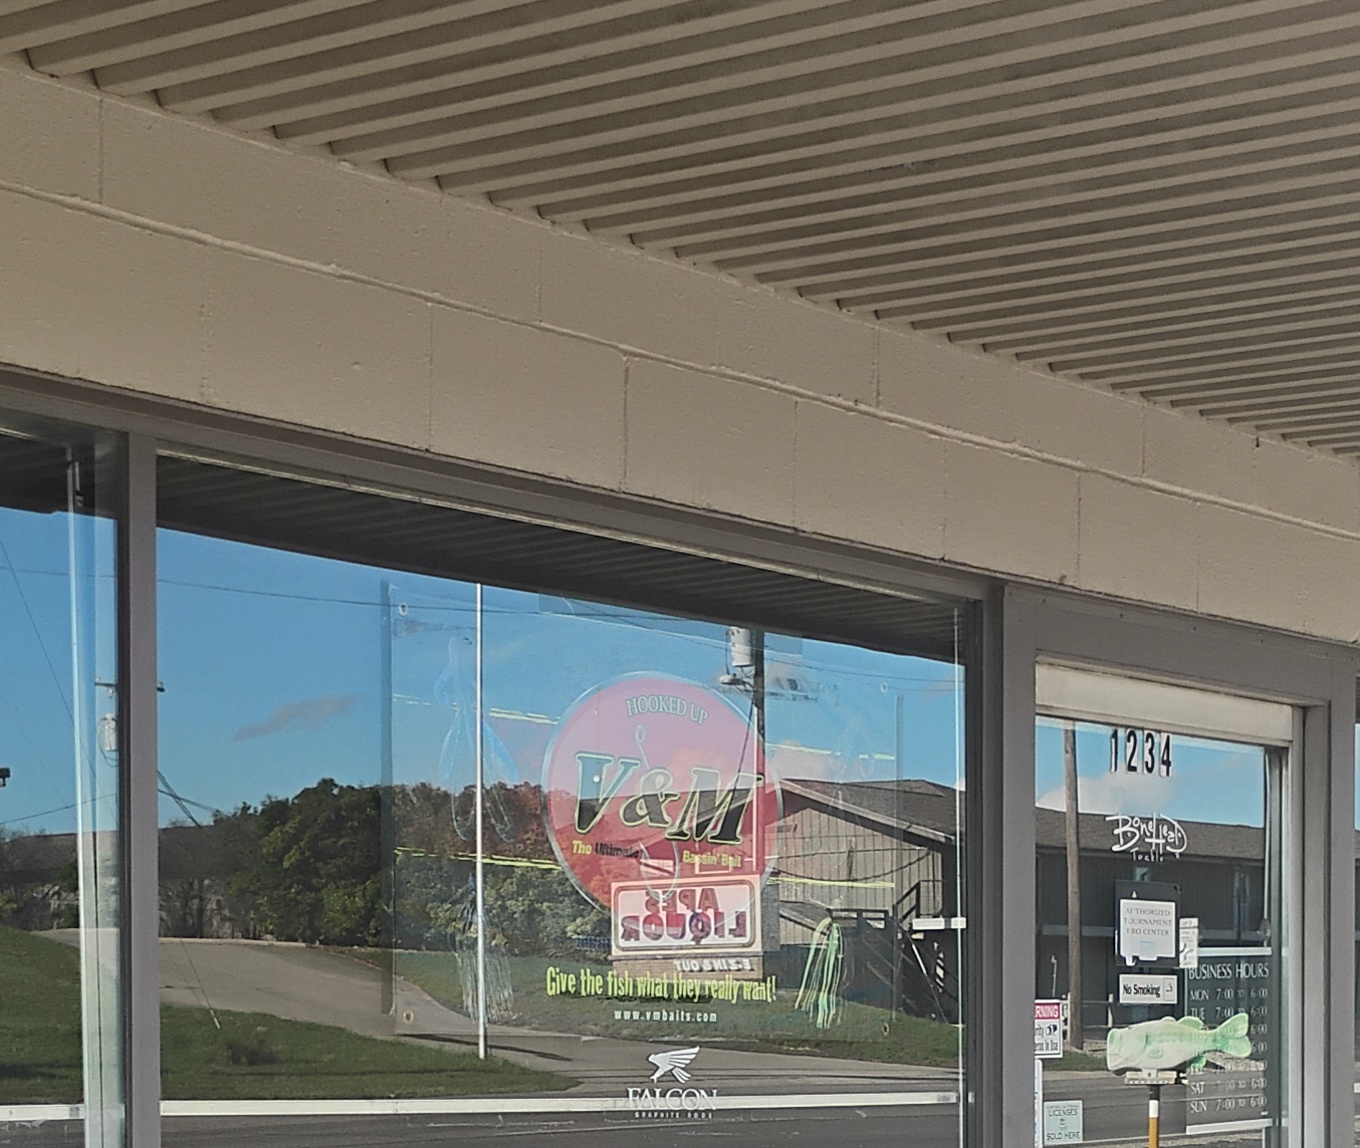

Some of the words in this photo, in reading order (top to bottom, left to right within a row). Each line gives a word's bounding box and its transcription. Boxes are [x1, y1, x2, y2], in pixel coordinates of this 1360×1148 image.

[626, 695, 687, 717] HOOKED
[690, 703, 709, 725] UP
[1110, 729, 1172, 776] 1234
[574, 751, 763, 845] V&M
[572, 840, 592, 855] The
[721, 853, 742, 868] Bait
[1143, 928, 1170, 937] CENTER
[1188, 963, 1232, 980] BUSINESS
[1236, 962, 1269, 978] HOURS
[545, 966, 576, 997] Give
[580, 968, 603, 997] the
[607, 970, 634, 997] fish
[636, 972, 669, 999] what
[672, 972, 701, 1002] they
[705, 974, 739, 1004] really
[742, 975, 778, 1003] want!
[1123, 983, 1132, 996] No
[1133, 983, 1162, 999] Smoking
[1190, 989, 1209, 1001] MON
[1216, 988, 1234, 1000] 7:00
[1250, 988, 1268, 999] 6:00
[613, 1009, 718, 1023] www.vmbaits.com
[1035, 1005, 1058, 1018] RNING
[1250, 1005, 1268, 1017] 6:00
[1190, 1082, 1205, 1095] SAT
[626, 1087, 718, 1110] FALCON
[1048, 1108, 1078, 1117] LICENSES
[1190, 1100, 1207, 1114] SUN
[1216, 1099, 1235, 1111] 7:00
[1046, 1132, 1063, 1141] SOLD
[1064, 1131, 1081, 1139] HERE
